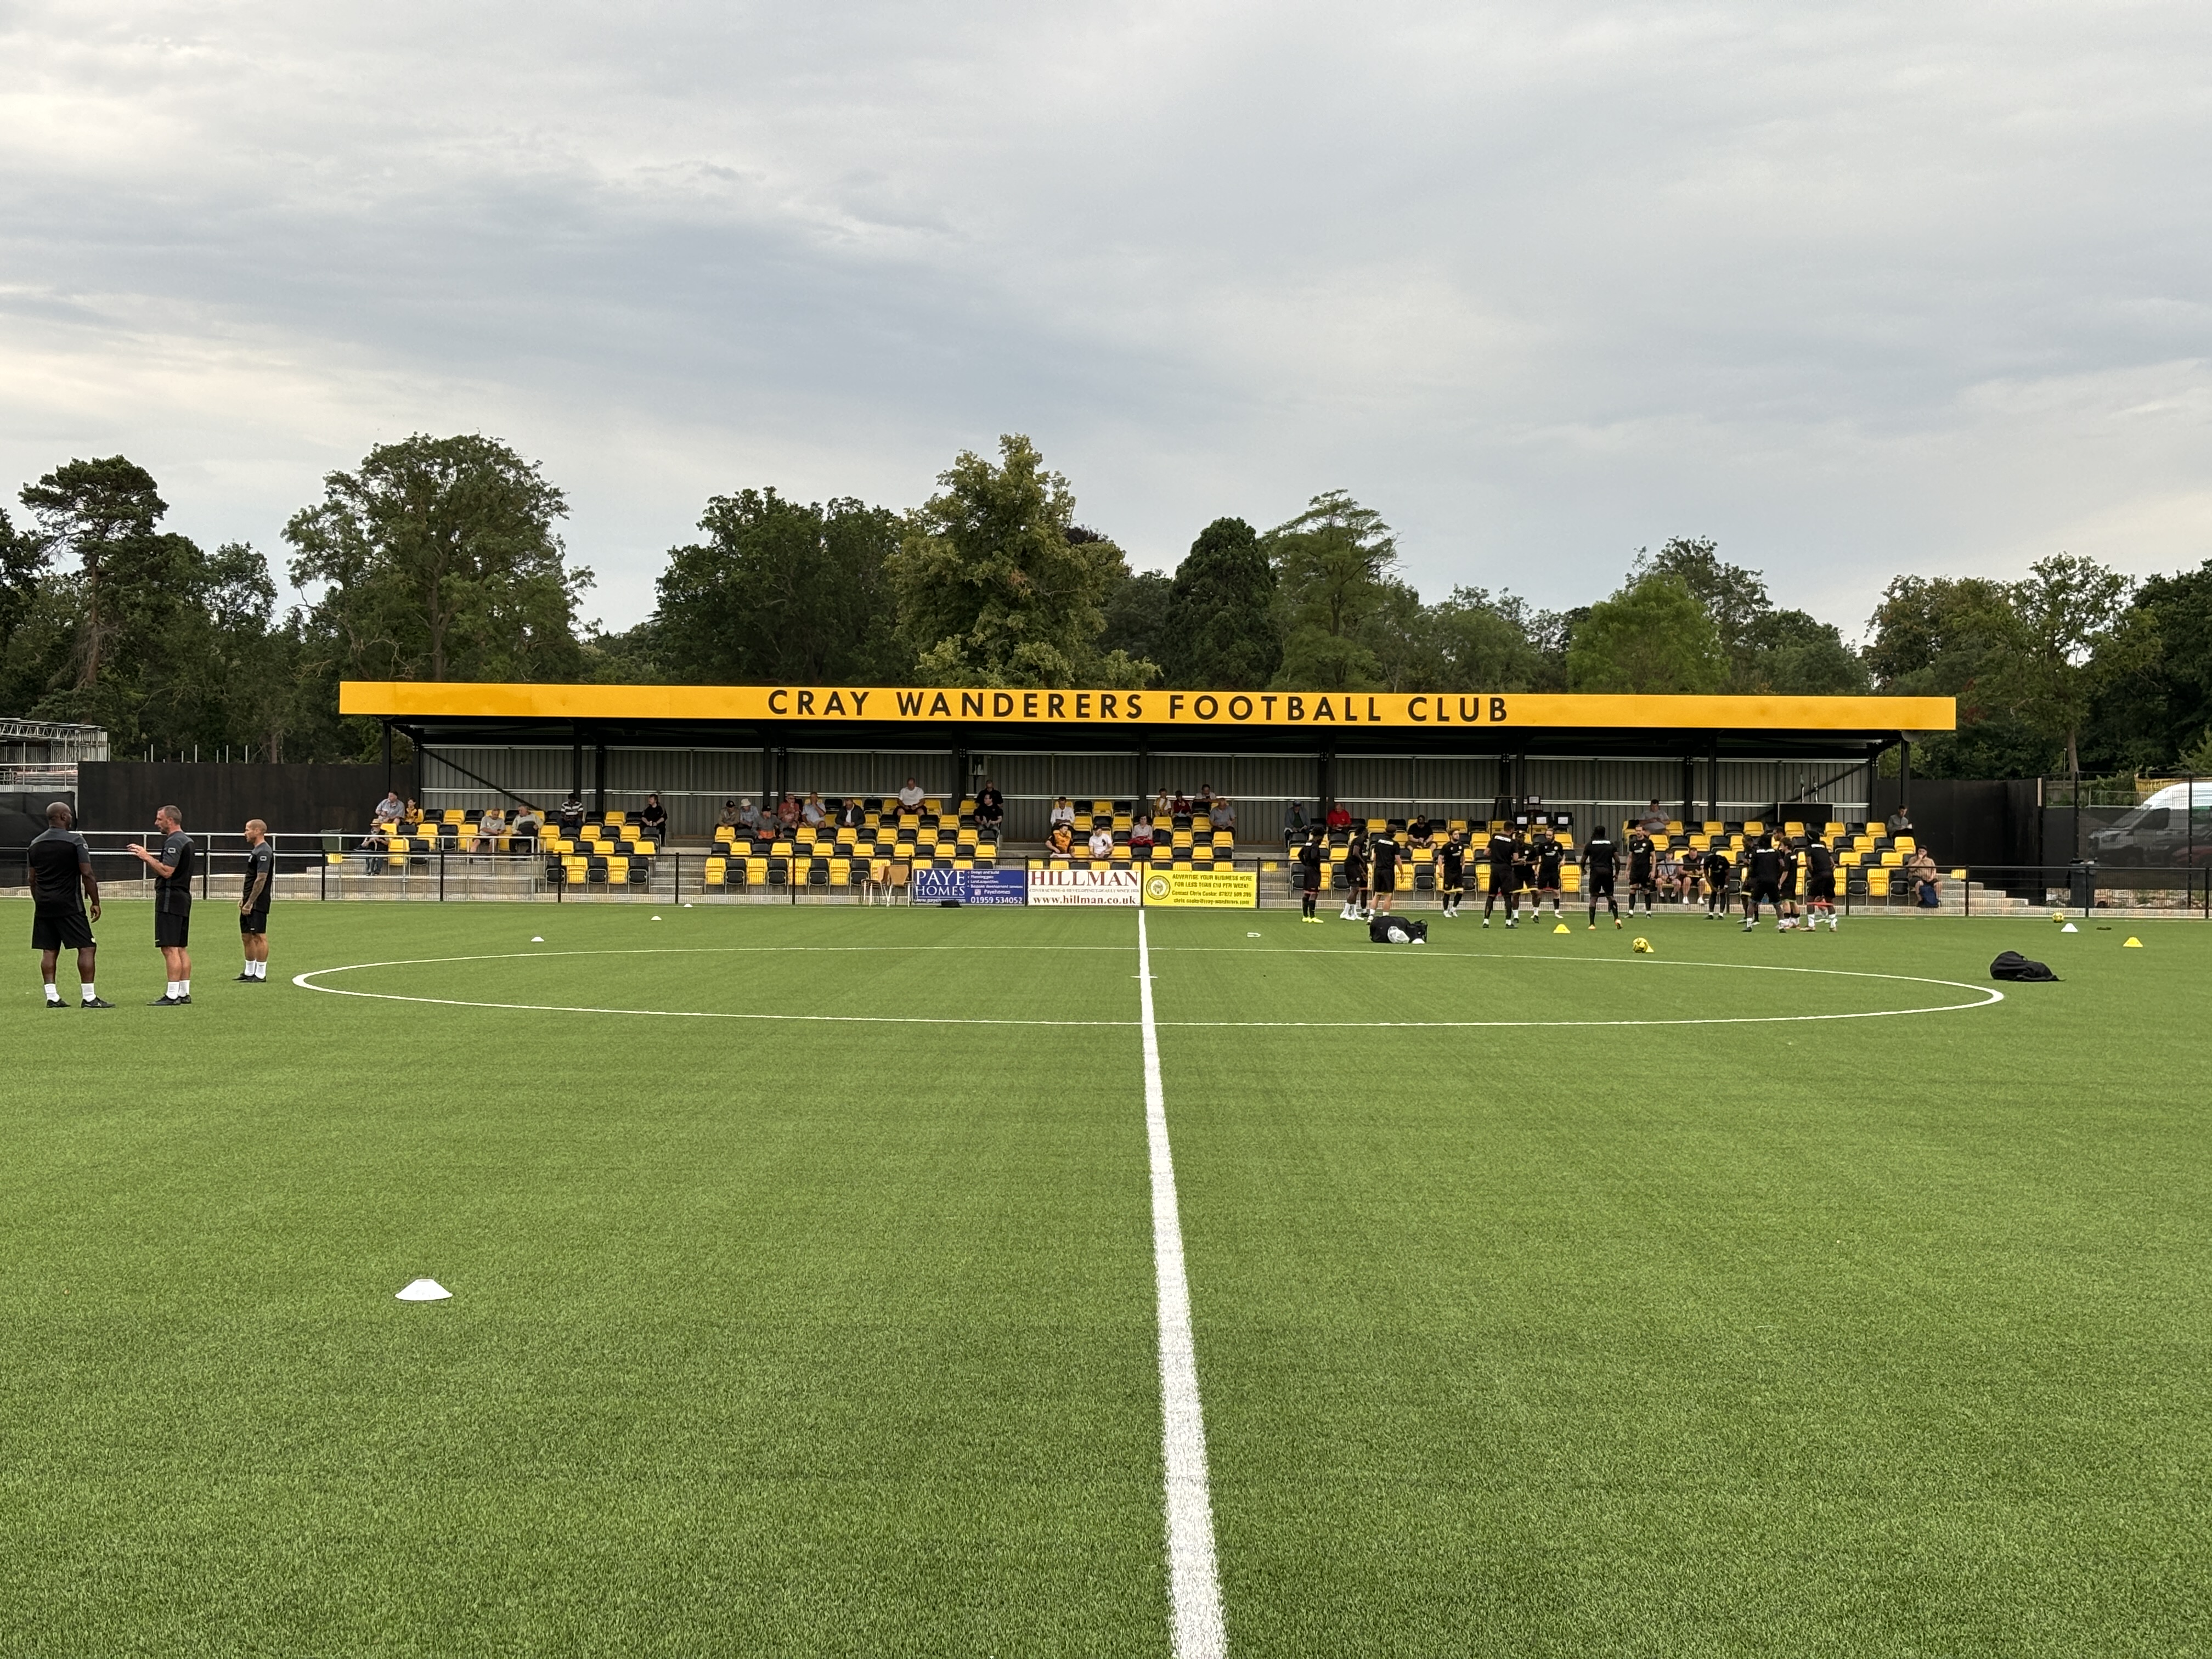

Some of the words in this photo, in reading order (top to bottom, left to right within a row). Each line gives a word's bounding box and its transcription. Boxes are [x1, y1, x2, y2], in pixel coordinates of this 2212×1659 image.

[769, 690, 870, 715] CRAY
[896, 691, 1142, 719] WANDERERS
[1169, 695, 1381, 721] FOOTBALL
[1408, 697, 1507, 721] CLUB
[916, 870, 966, 885] PAYE
[1029, 871, 1139, 886] HILLMAN
[916, 886, 965, 896] HOMES
[1033, 895, 1136, 904] www.hillman.co.uk
